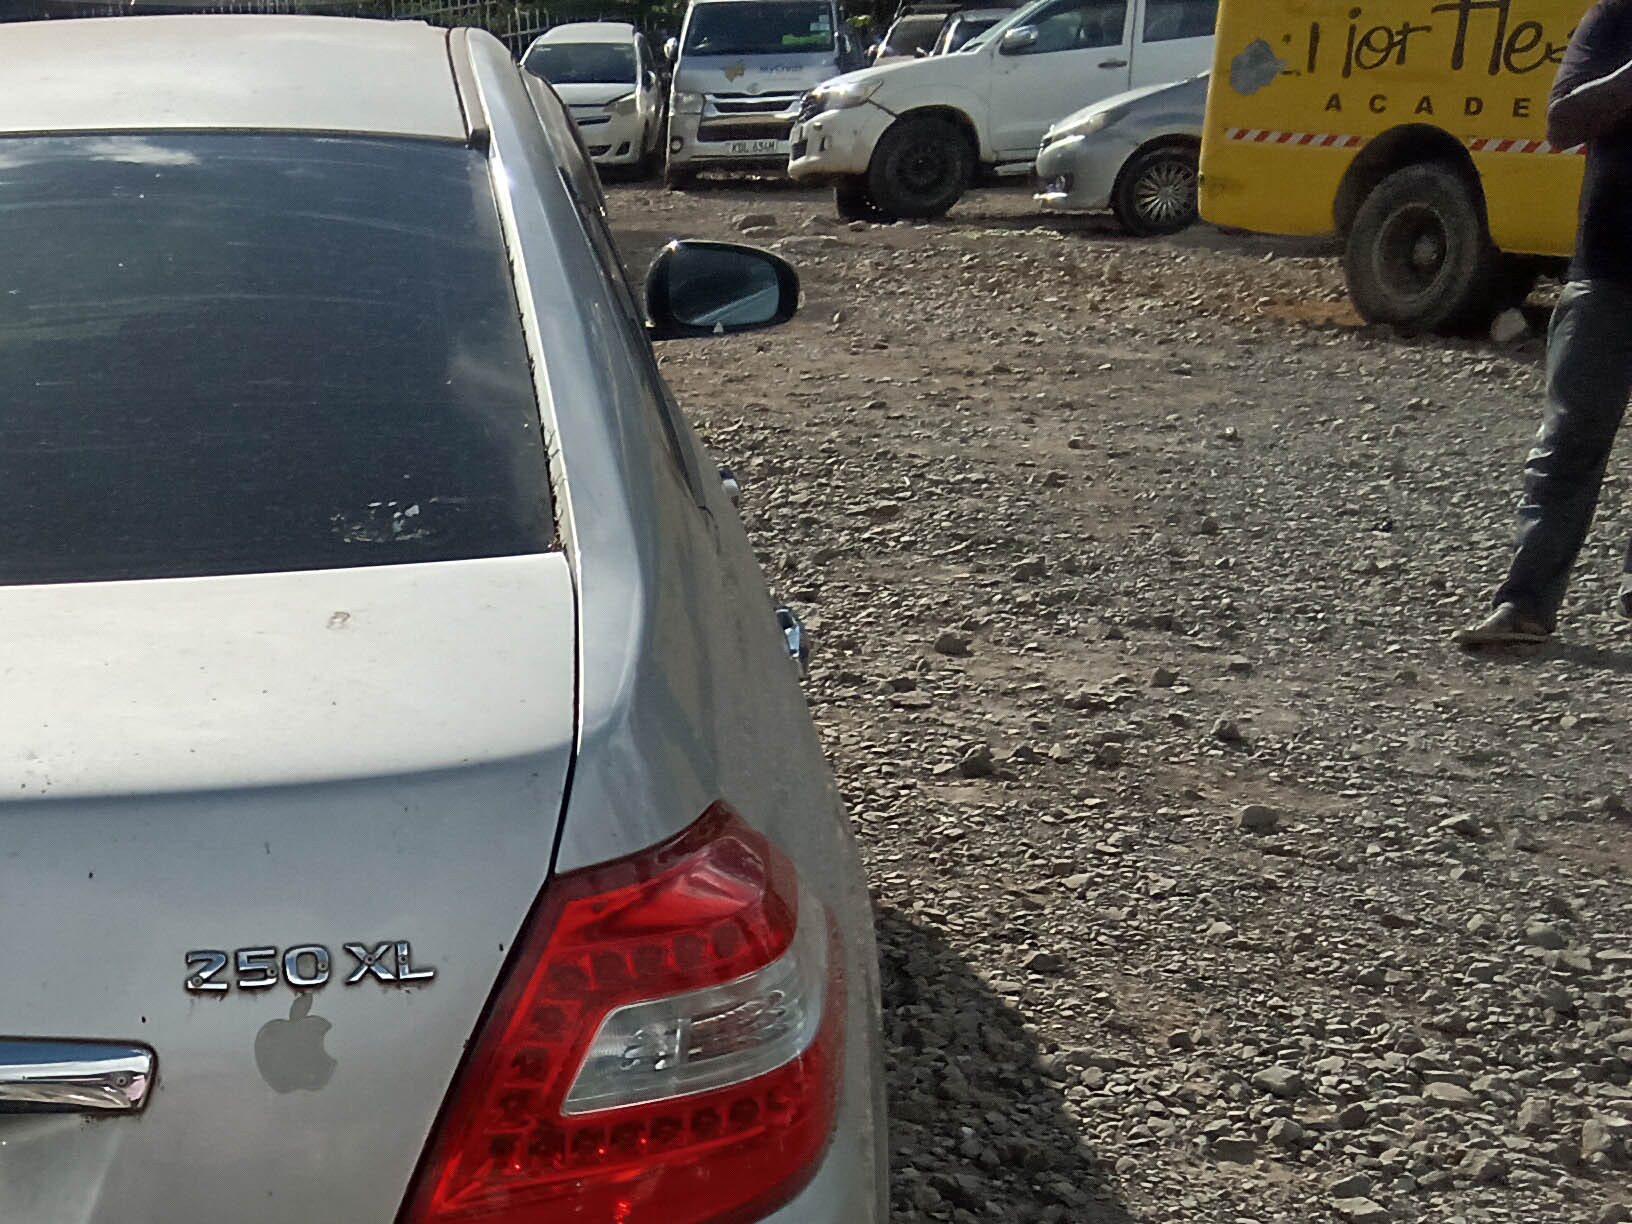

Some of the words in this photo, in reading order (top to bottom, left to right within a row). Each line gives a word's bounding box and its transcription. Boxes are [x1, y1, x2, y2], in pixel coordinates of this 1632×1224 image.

[1324, 93, 1532, 119] ACADE
[184, 944, 331, 991] 250
[342, 940, 438, 986] XL
